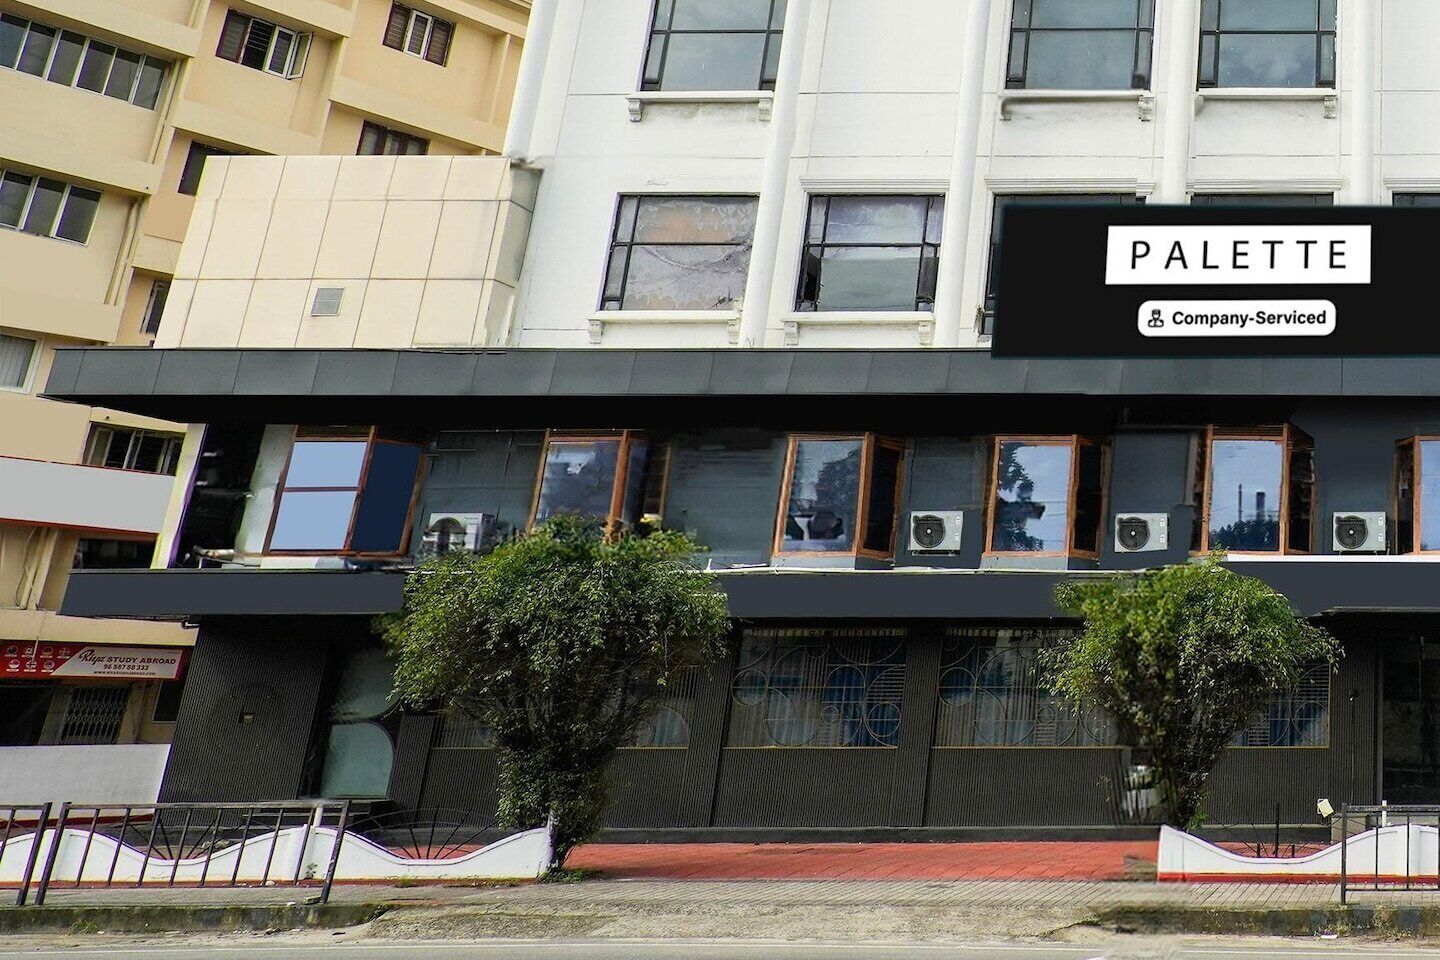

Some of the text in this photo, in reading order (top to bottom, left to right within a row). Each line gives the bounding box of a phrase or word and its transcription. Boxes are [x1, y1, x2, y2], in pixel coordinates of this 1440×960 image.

[1131, 240, 1346, 269] PALETTE
[1172, 310, 1326, 328] Company-Serviced
[139, 657, 177, 665] ABROAD
